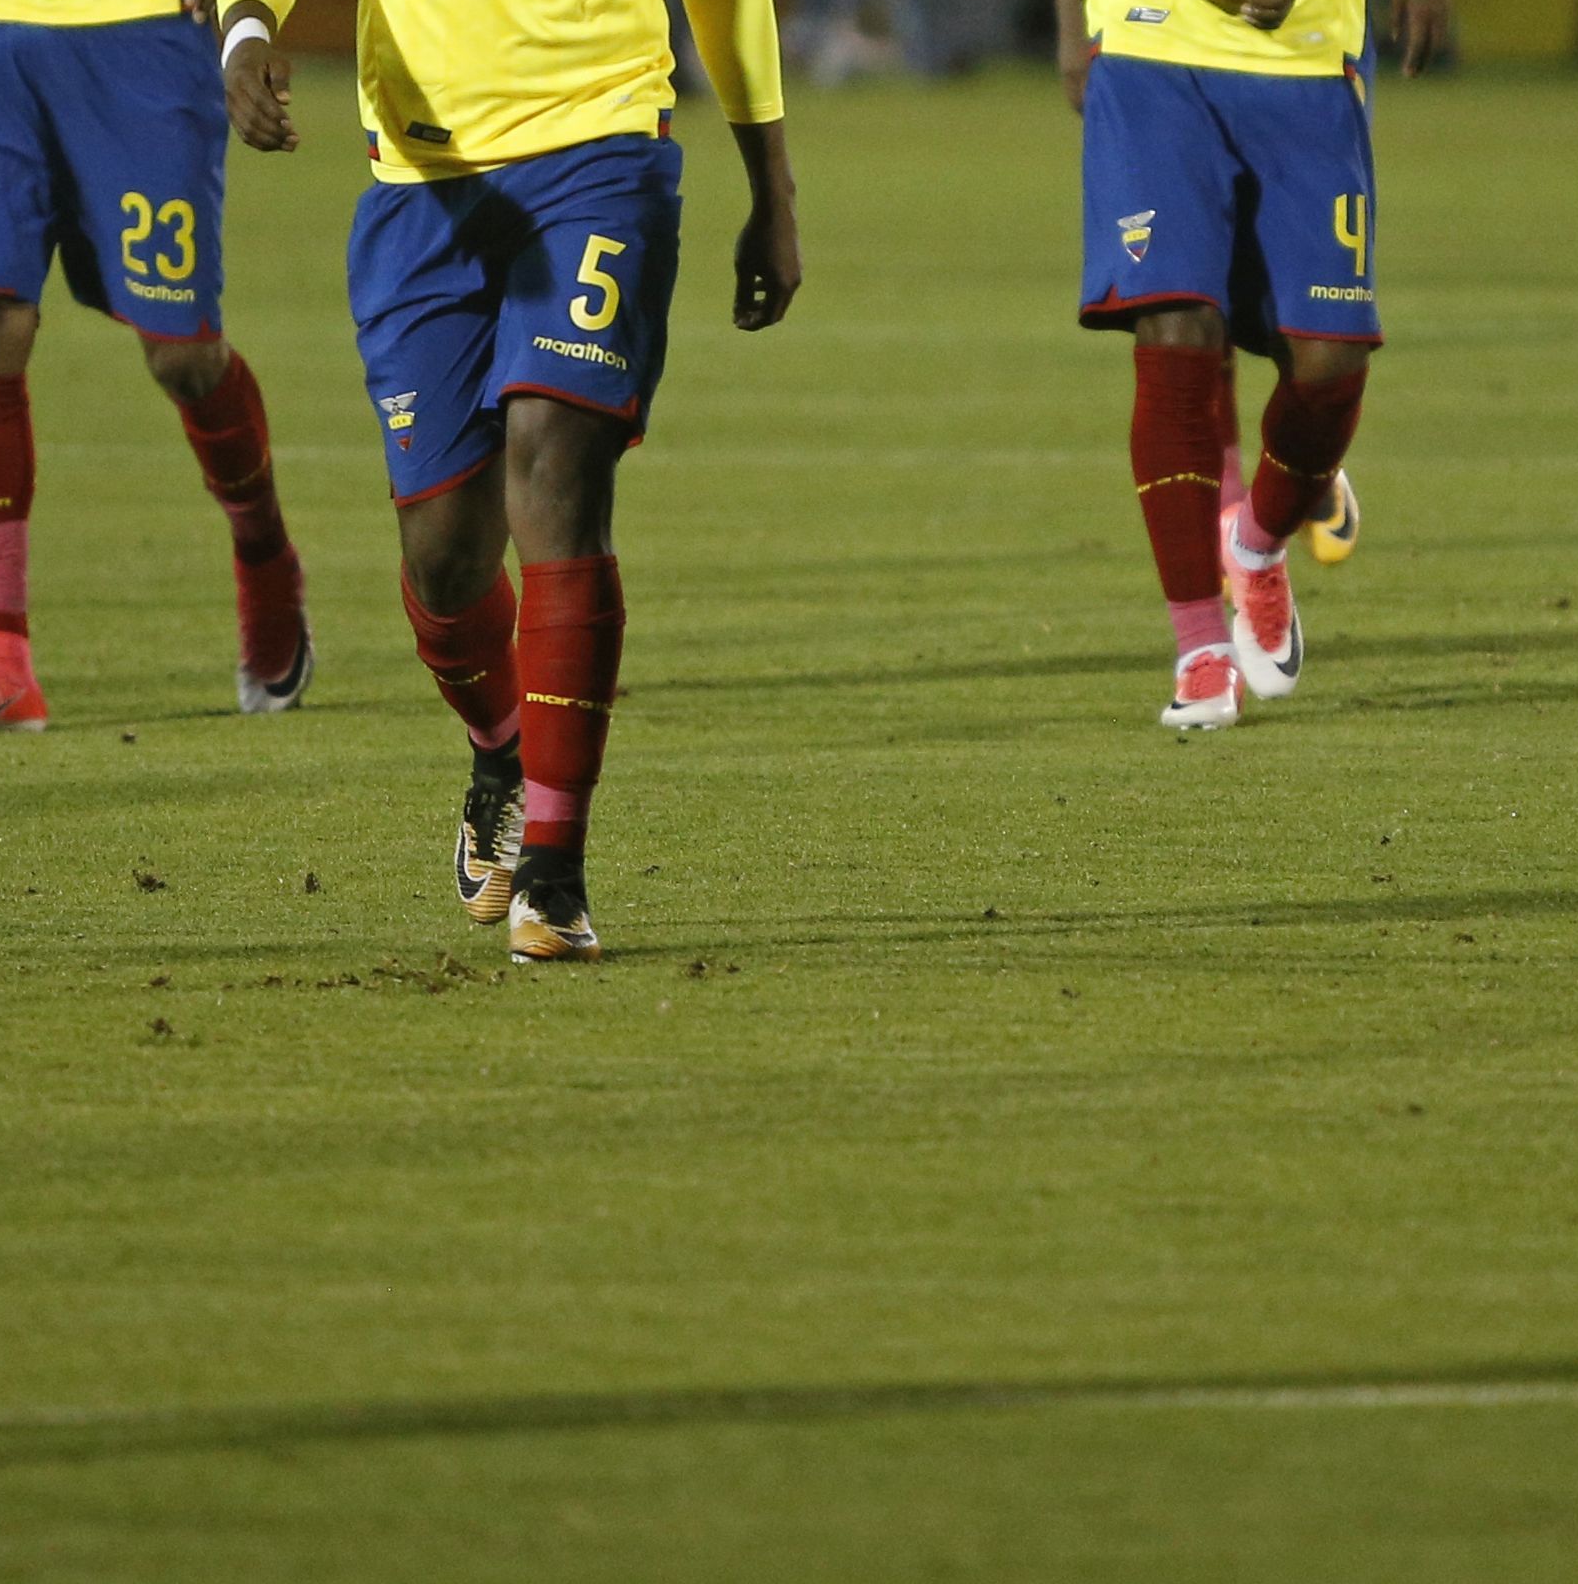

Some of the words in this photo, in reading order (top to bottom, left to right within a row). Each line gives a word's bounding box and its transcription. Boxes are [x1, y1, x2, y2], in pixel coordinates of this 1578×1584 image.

[120, 191, 197, 281] 23
[1334, 193, 1367, 277] 4
[569, 234, 627, 331] 5
[532, 335, 627, 370] marathon
